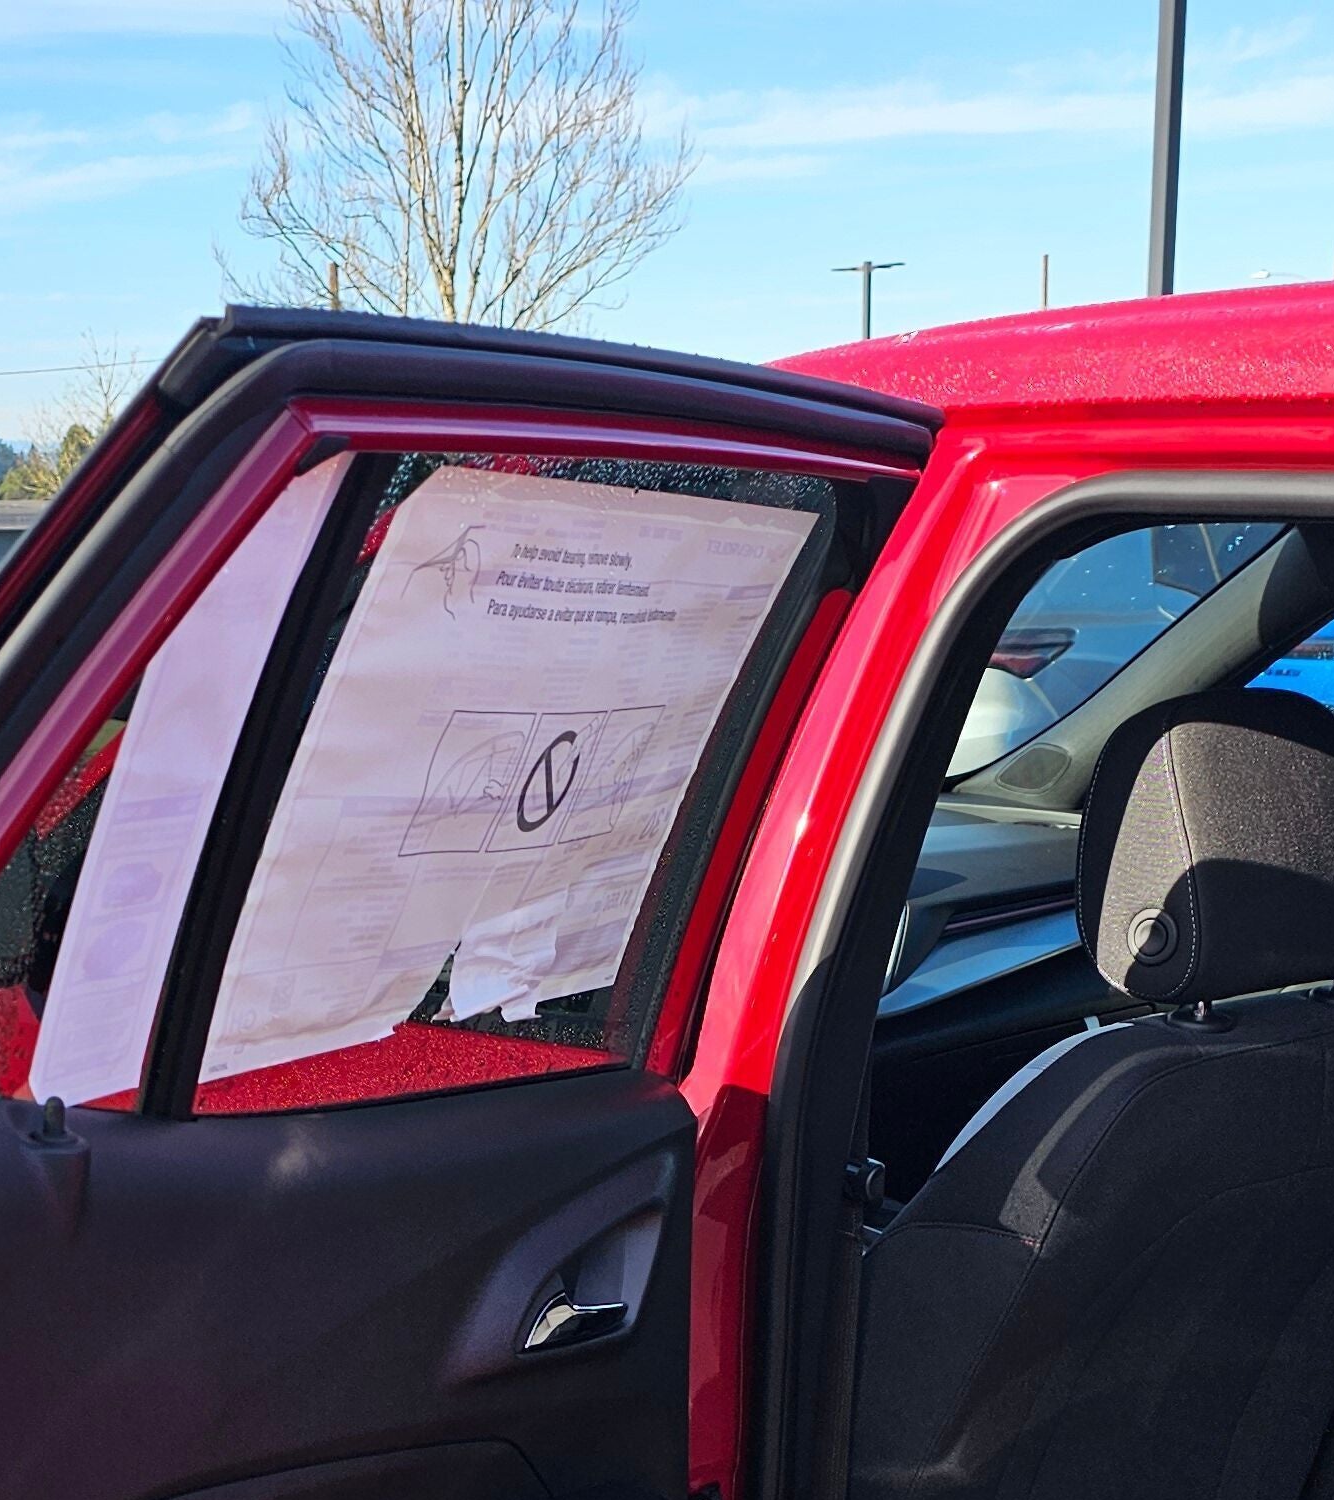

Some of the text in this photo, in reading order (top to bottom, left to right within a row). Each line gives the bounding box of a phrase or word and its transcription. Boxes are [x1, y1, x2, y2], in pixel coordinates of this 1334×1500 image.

[510, 543, 522, 559] To
[520, 544, 539, 566] help
[538, 547, 563, 563] avoid
[496, 570, 518, 587] Pour
[517, 571, 544, 591] éviter
[542, 575, 565, 593] toute
[486, 598, 509, 617] Para
[546, 608, 555, 622] a
